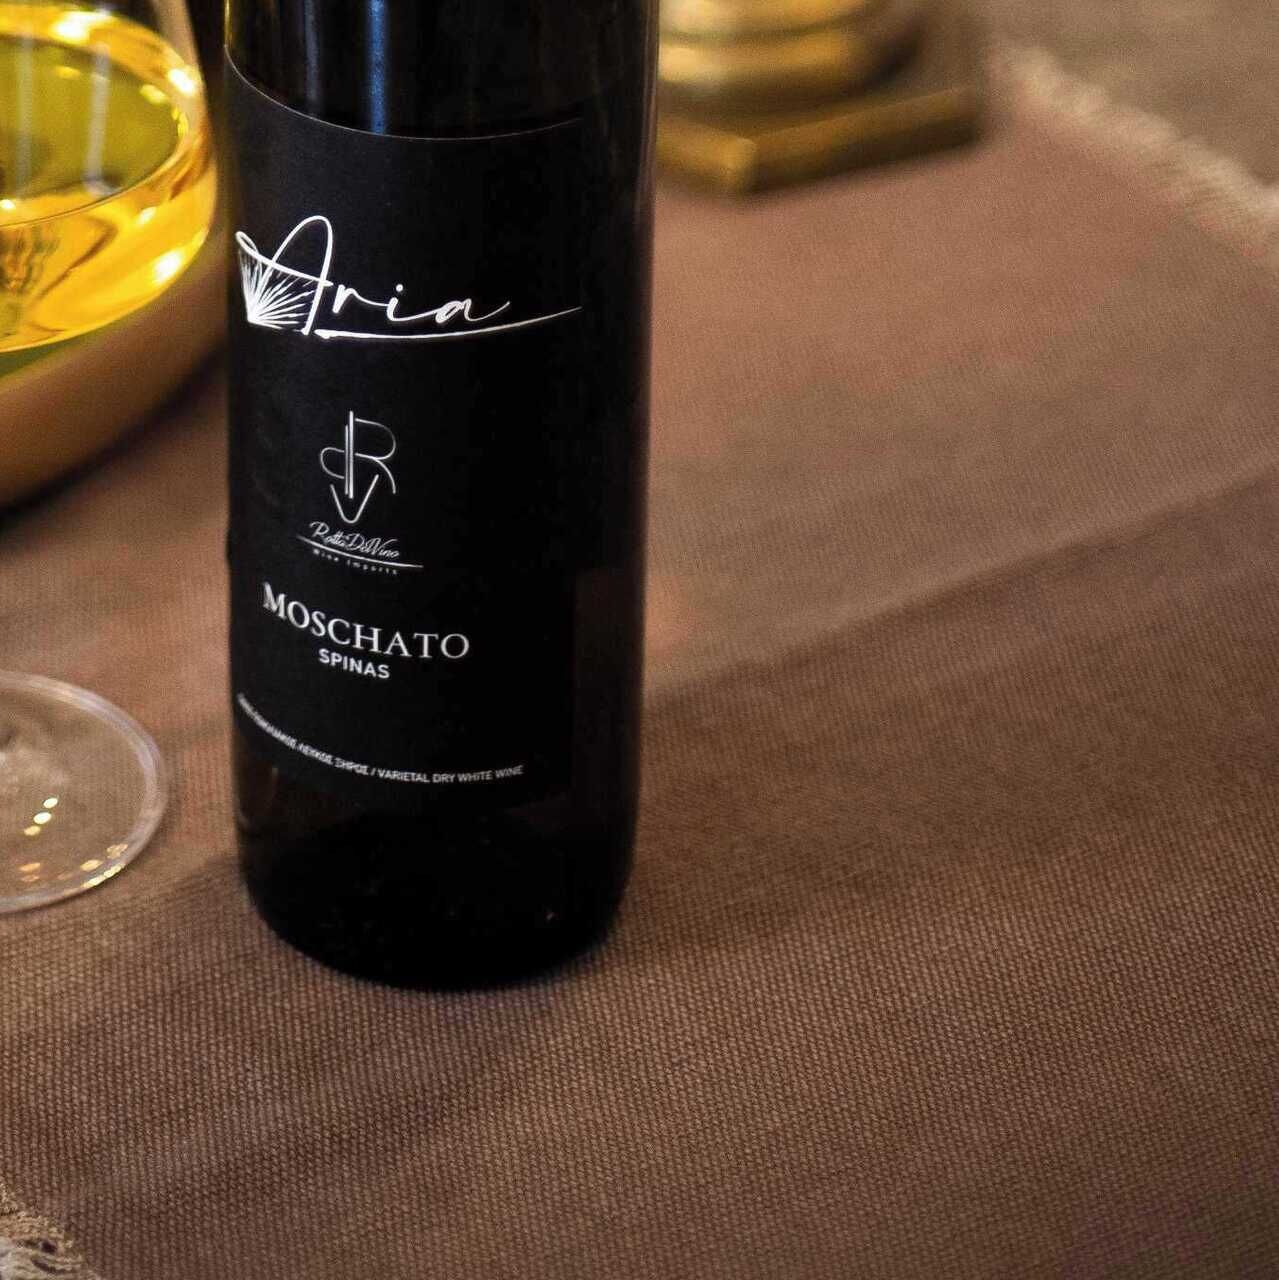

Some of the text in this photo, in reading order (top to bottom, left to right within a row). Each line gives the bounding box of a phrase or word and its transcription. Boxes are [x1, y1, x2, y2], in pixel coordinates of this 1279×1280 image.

[235, 215, 510, 336] Aria
[263, 581, 470, 659] MOSCHATO
[318, 648, 391, 679] SPINAS
[377, 768, 431, 783] VARIETAL
[432, 773, 455, 783] DRY
[457, 770, 493, 783] WHITE
[495, 764, 524, 779] WINE
